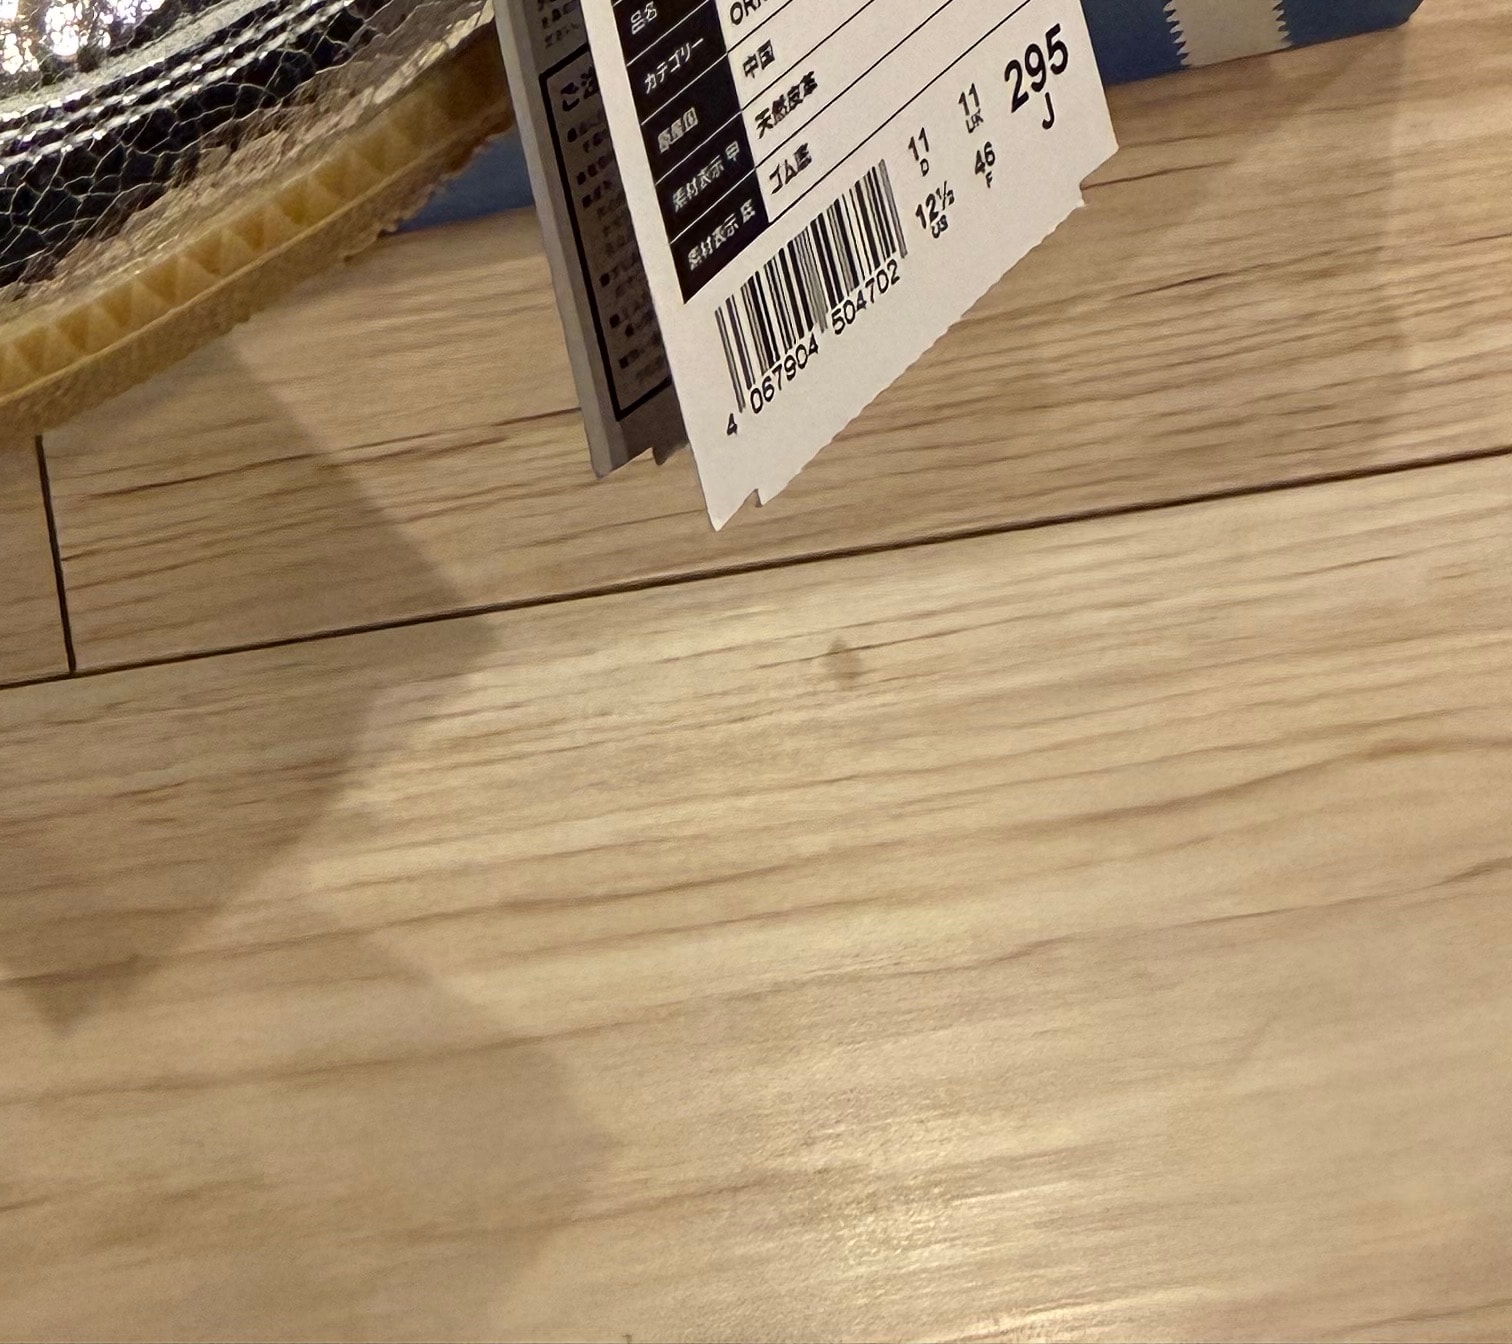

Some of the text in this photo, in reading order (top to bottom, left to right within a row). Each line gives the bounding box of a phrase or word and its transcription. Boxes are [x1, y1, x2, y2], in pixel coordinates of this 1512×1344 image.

[630, 1, 658, 35] 品名
[644, 38, 704, 94] カテゴリー
[742, 39, 776, 79] 中国
[1004, 23, 1069, 114] 295
[754, 70, 818, 139] 天然皮革
[958, 82, 980, 116] 11
[1041, 91, 1055, 130] J
[908, 127, 930, 162] 11
[974, 141, 996, 175] 46
[769, 142, 812, 195] ゴム底
[919, 158, 930, 177] D
[726, 258, 901, 436] 4 067904 504702
